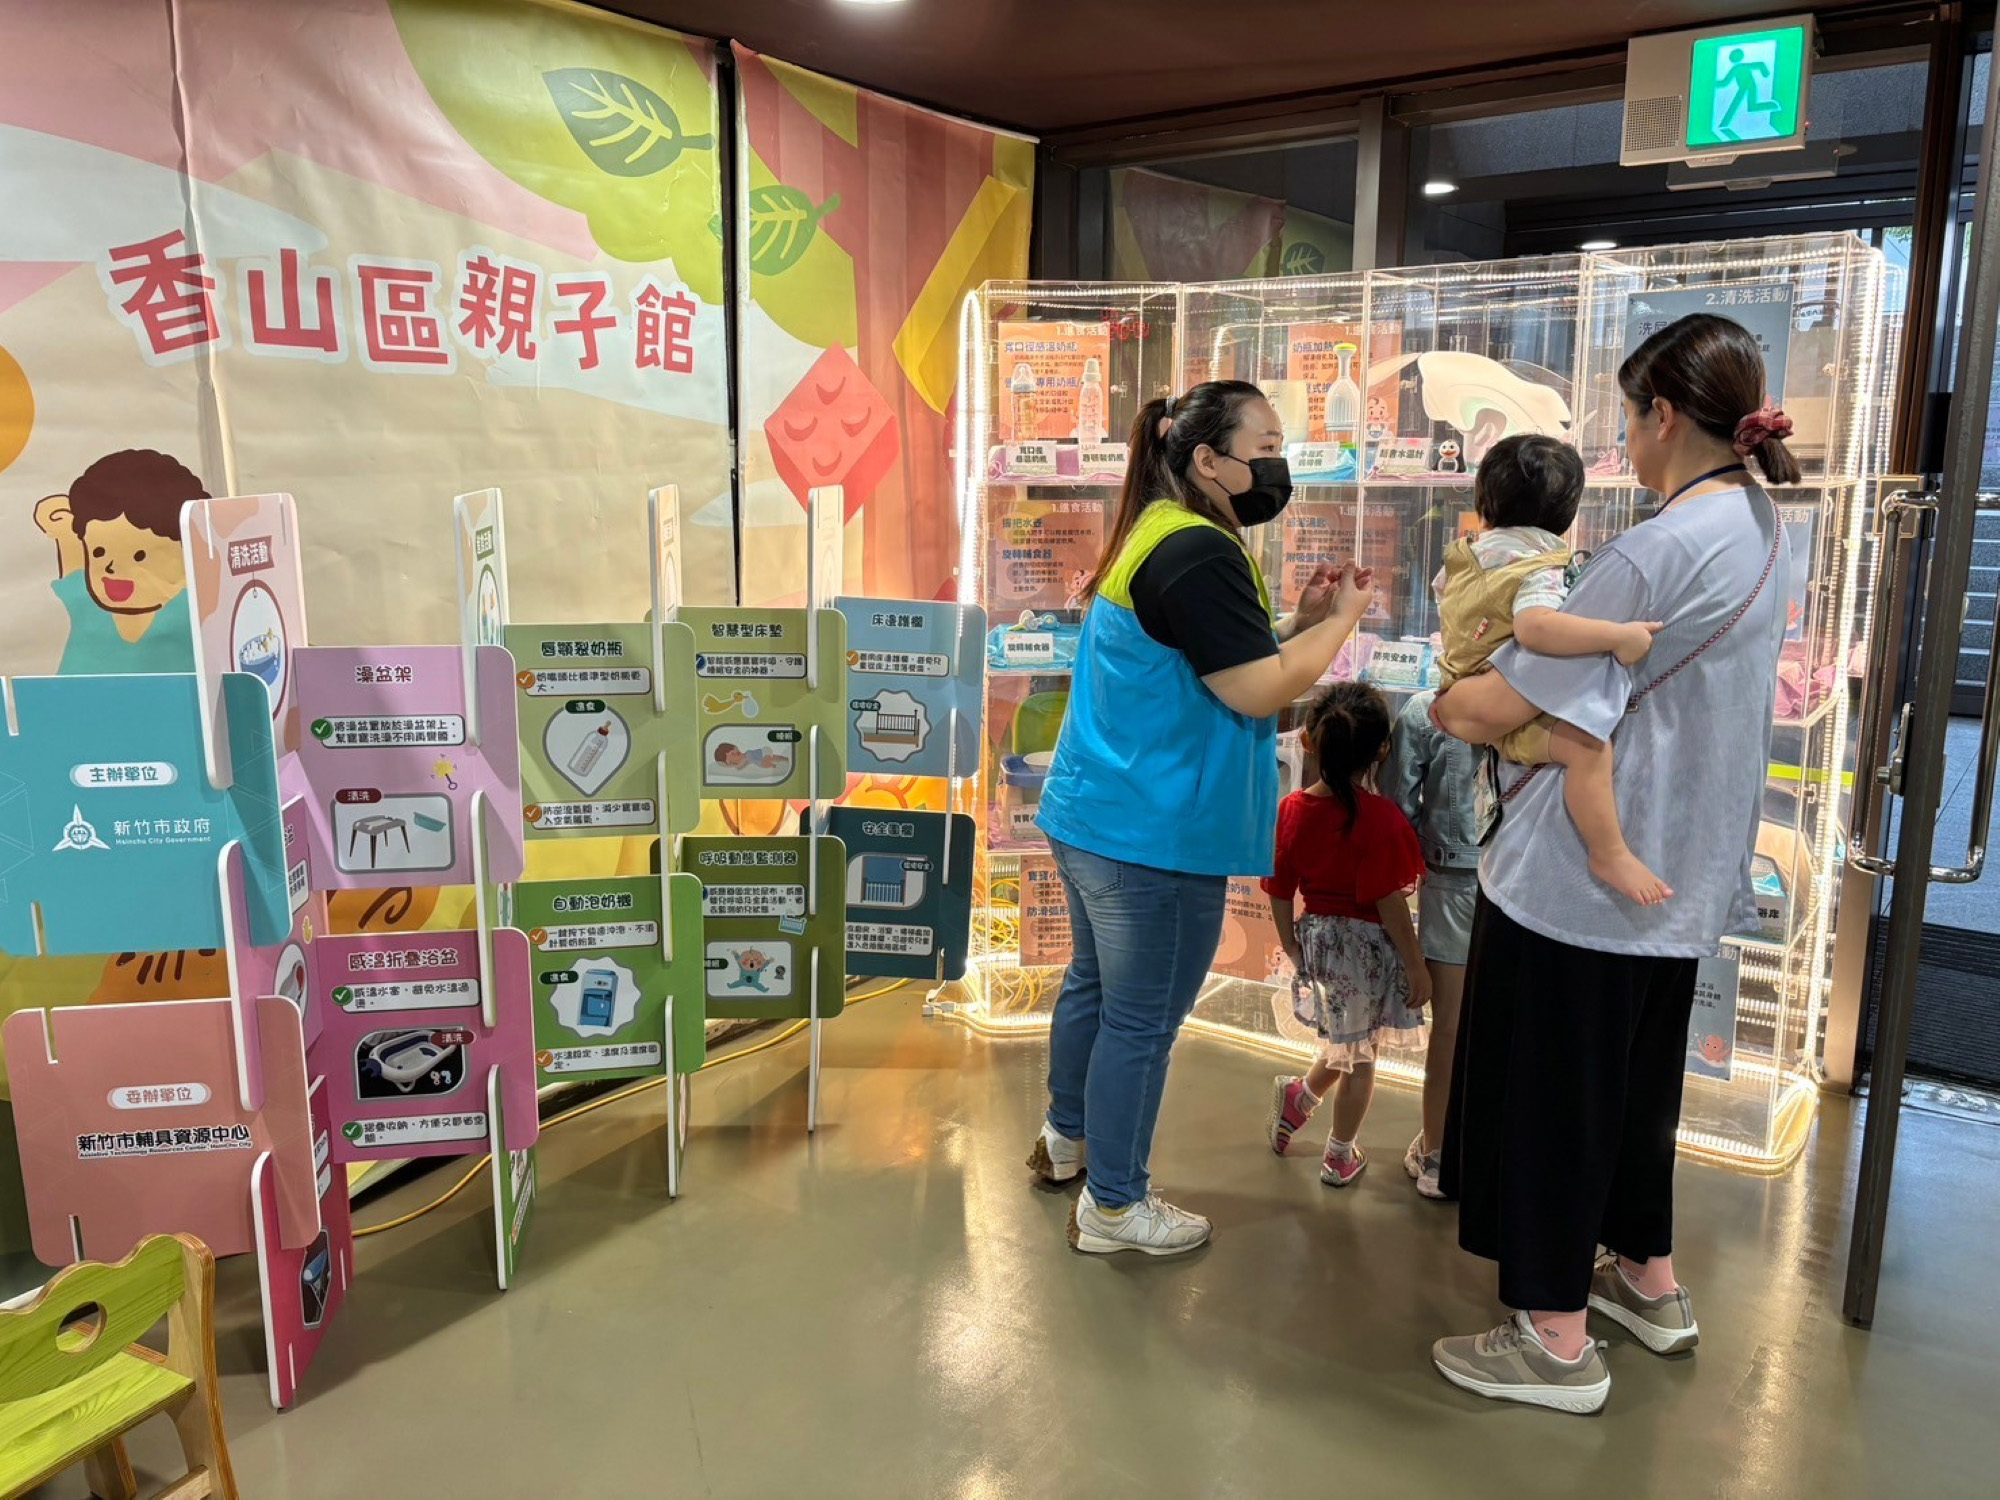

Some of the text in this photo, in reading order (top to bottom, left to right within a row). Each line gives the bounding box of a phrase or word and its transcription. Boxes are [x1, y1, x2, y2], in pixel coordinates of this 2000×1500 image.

[108, 229, 696, 374] 香山區親子館
[1706, 287, 1789, 305] 2.清洗活動
[230, 541, 268, 569] 清洗活動
[871, 614, 924, 628] 床邊護欄
[711, 623, 783, 638] 智慧型床墊
[541, 641, 623, 657] 唇顎裂奶瓶
[356, 666, 412, 683] 澡盆架
[89, 766, 159, 783] 主辦單位
[348, 790, 370, 801] 清洗
[113, 818, 211, 836] 新竹市政府
[148, 837, 164, 846] City
[165, 836, 211, 845] Government
[699, 852, 798, 865] 呼吸動態監測器
[553, 893, 632, 911] 自動泡奶機
[349, 949, 459, 971] 感溫折疊浴盆
[441, 1032, 463, 1044] 清洗
[126, 1086, 193, 1104] 委辦單位
[77, 1124, 249, 1151] 新竹市輔具資源中心
